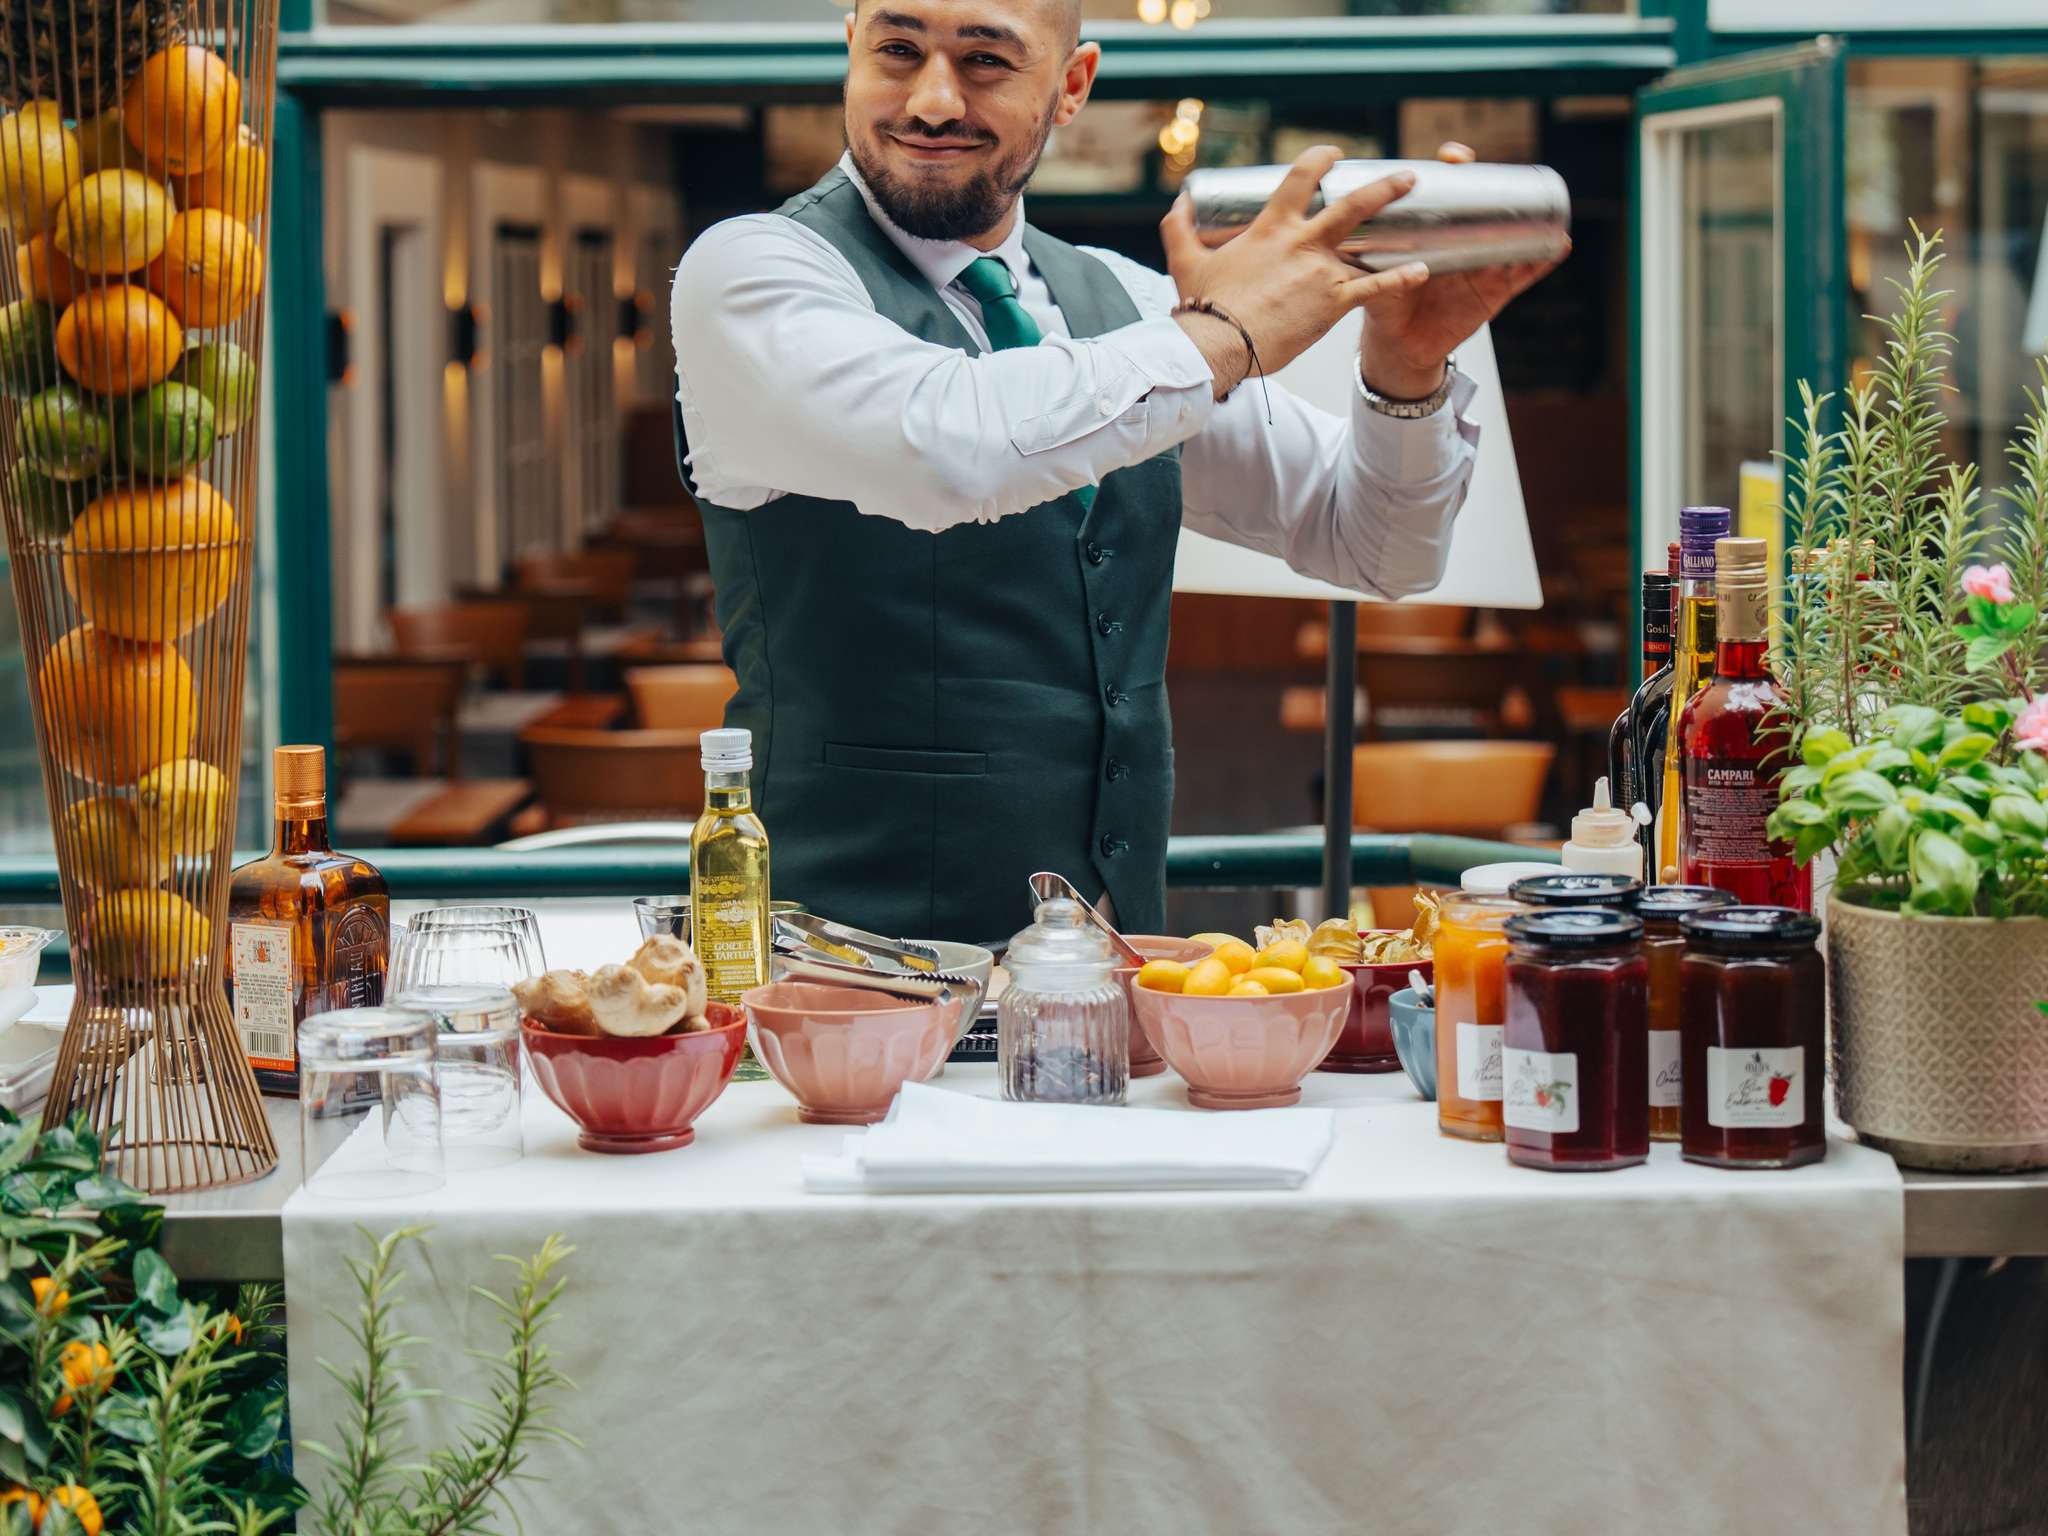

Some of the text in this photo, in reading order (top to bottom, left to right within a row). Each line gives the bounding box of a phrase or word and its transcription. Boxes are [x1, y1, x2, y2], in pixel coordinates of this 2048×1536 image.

[1683, 553, 1715, 569] GALLIANO
[1646, 623, 1669, 634] Gosli
[1707, 769, 1754, 780] CAMPARI
[350, 950, 365, 1009] NTREAU
